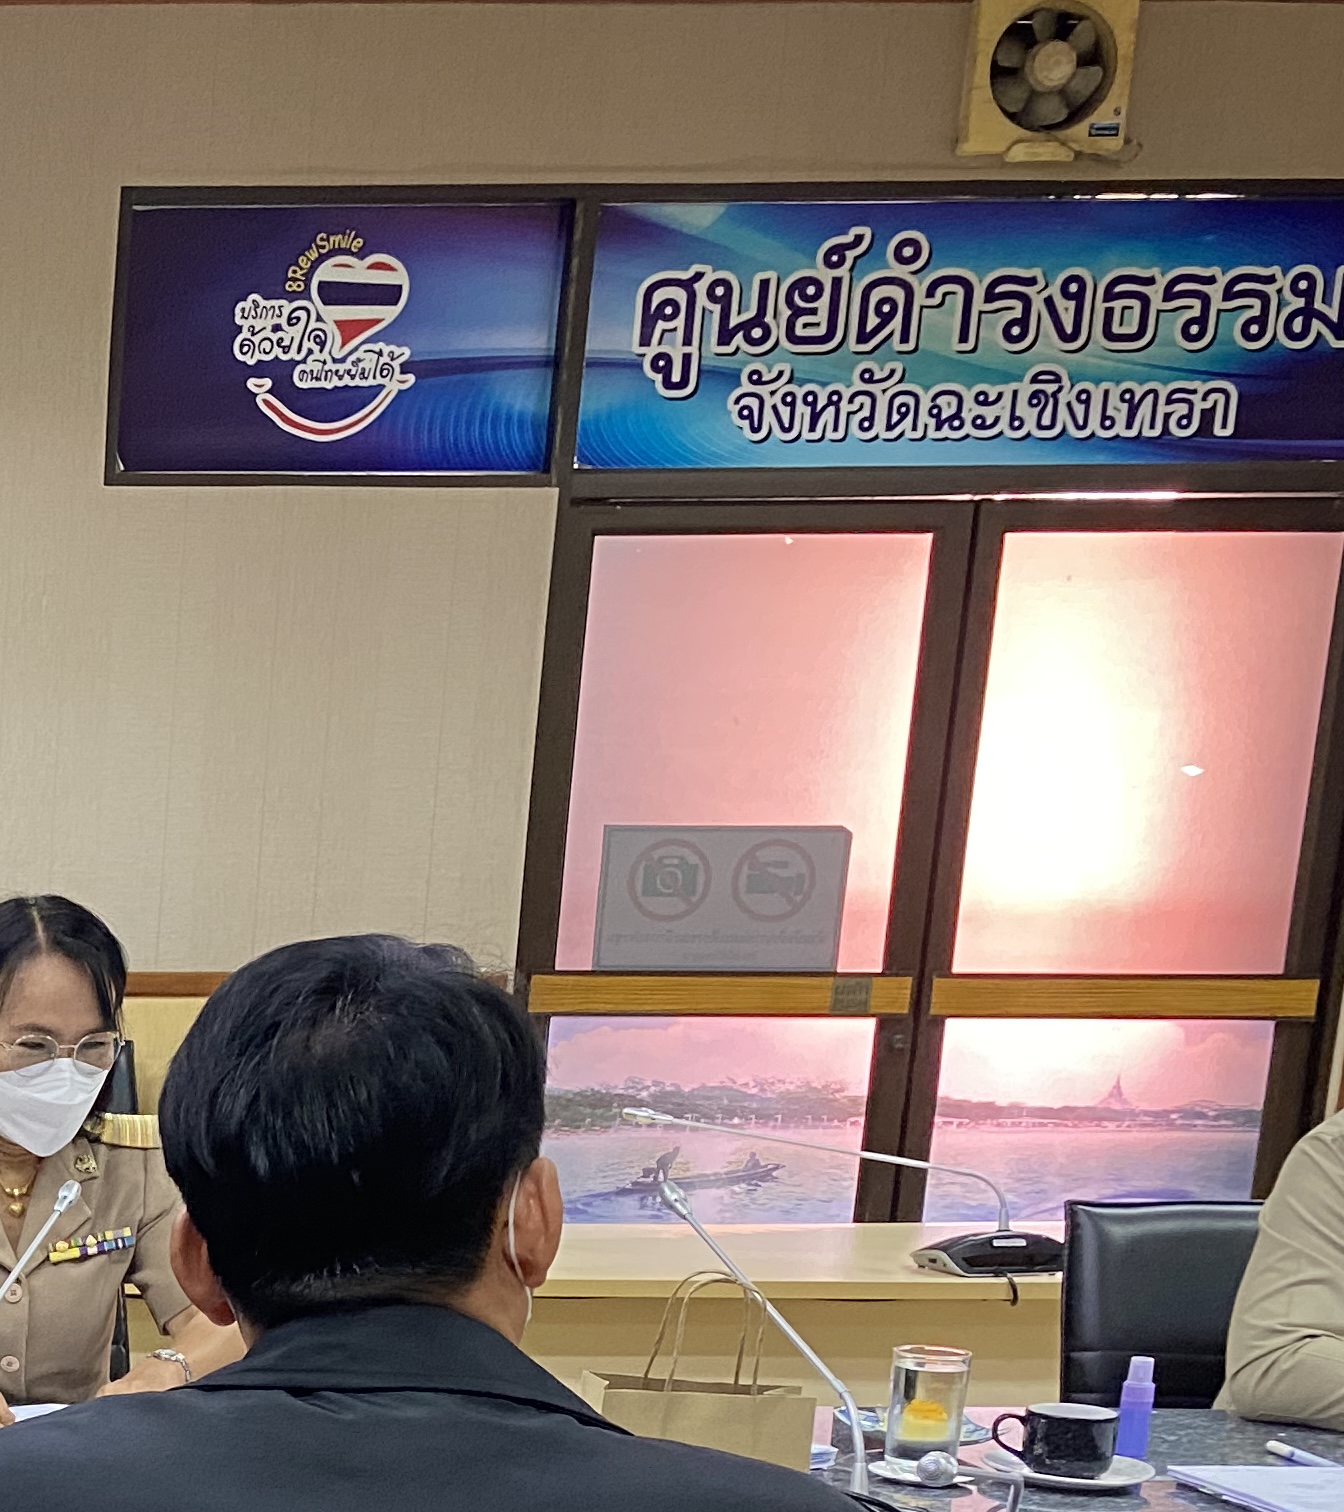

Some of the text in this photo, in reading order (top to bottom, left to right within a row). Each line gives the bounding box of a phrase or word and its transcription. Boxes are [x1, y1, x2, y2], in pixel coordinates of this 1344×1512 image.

[239, 305, 328, 360] ด้วยใจ
[240, 299, 284, 321] บริการ
[635, 228, 1344, 397] ศูนย์ดำรงธรรม
[730, 363, 1236, 441] จังหวัดฉะเชิงเทรา
